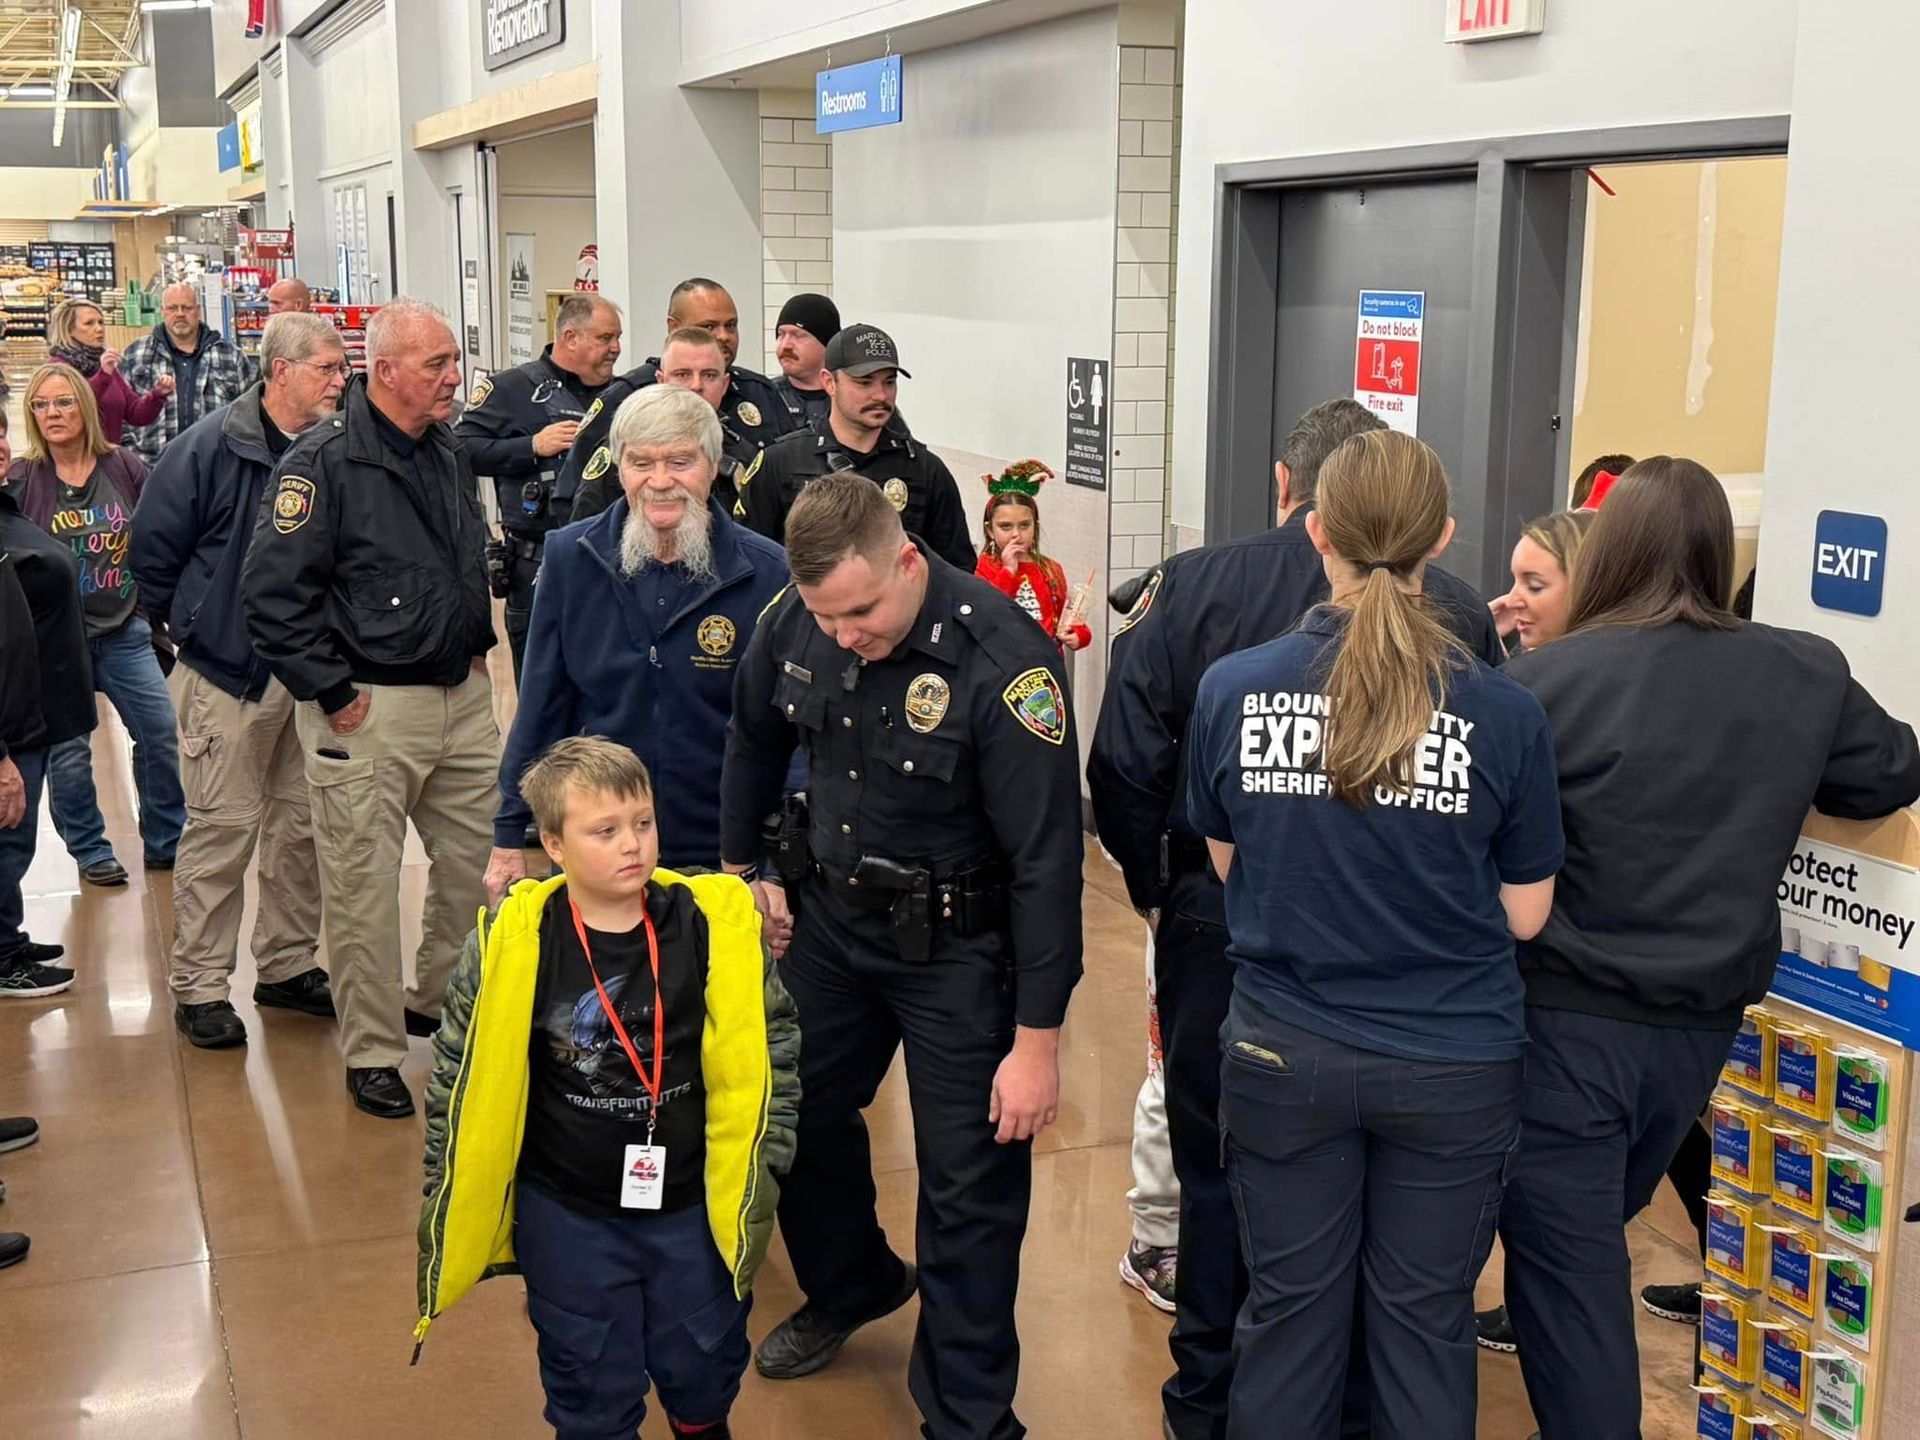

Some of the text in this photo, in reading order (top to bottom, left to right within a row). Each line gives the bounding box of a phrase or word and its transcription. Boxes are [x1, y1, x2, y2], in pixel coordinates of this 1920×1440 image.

[487, 0, 548, 55] Renovator
[822, 90, 867, 116] Restrooms
[575, 281, 599, 291] JO
[1362, 320, 1418, 337] Do not block
[865, 349, 892, 358] POLICE
[1368, 394, 1404, 412] Fire exit
[71, 531, 129, 565] very
[1817, 543, 1878, 581] EXIT
[79, 557, 135, 599] hing
[1243, 692, 1341, 716] BLOUN
[1240, 716, 1472, 789] EXPER
[1374, 784, 1469, 814] OFFICE
[1789, 851, 1859, 892] otect
[1776, 880, 1915, 949] our money
[1733, 1041, 1761, 1057] oneyCard
[1780, 1059, 1815, 1078] MoneyCard
[1842, 1090, 1872, 1109] Visa Debit
[1715, 1133, 1748, 1152] MoneyCard
[1776, 1158, 1811, 1178] MoneyCard
[1832, 1190, 1861, 1210] Visa Debit
[1774, 1254, 1808, 1276] MoneyCard
[1832, 1290, 1860, 1310] Visa Debit
[1765, 1351, 1799, 1373] MoneyCard
